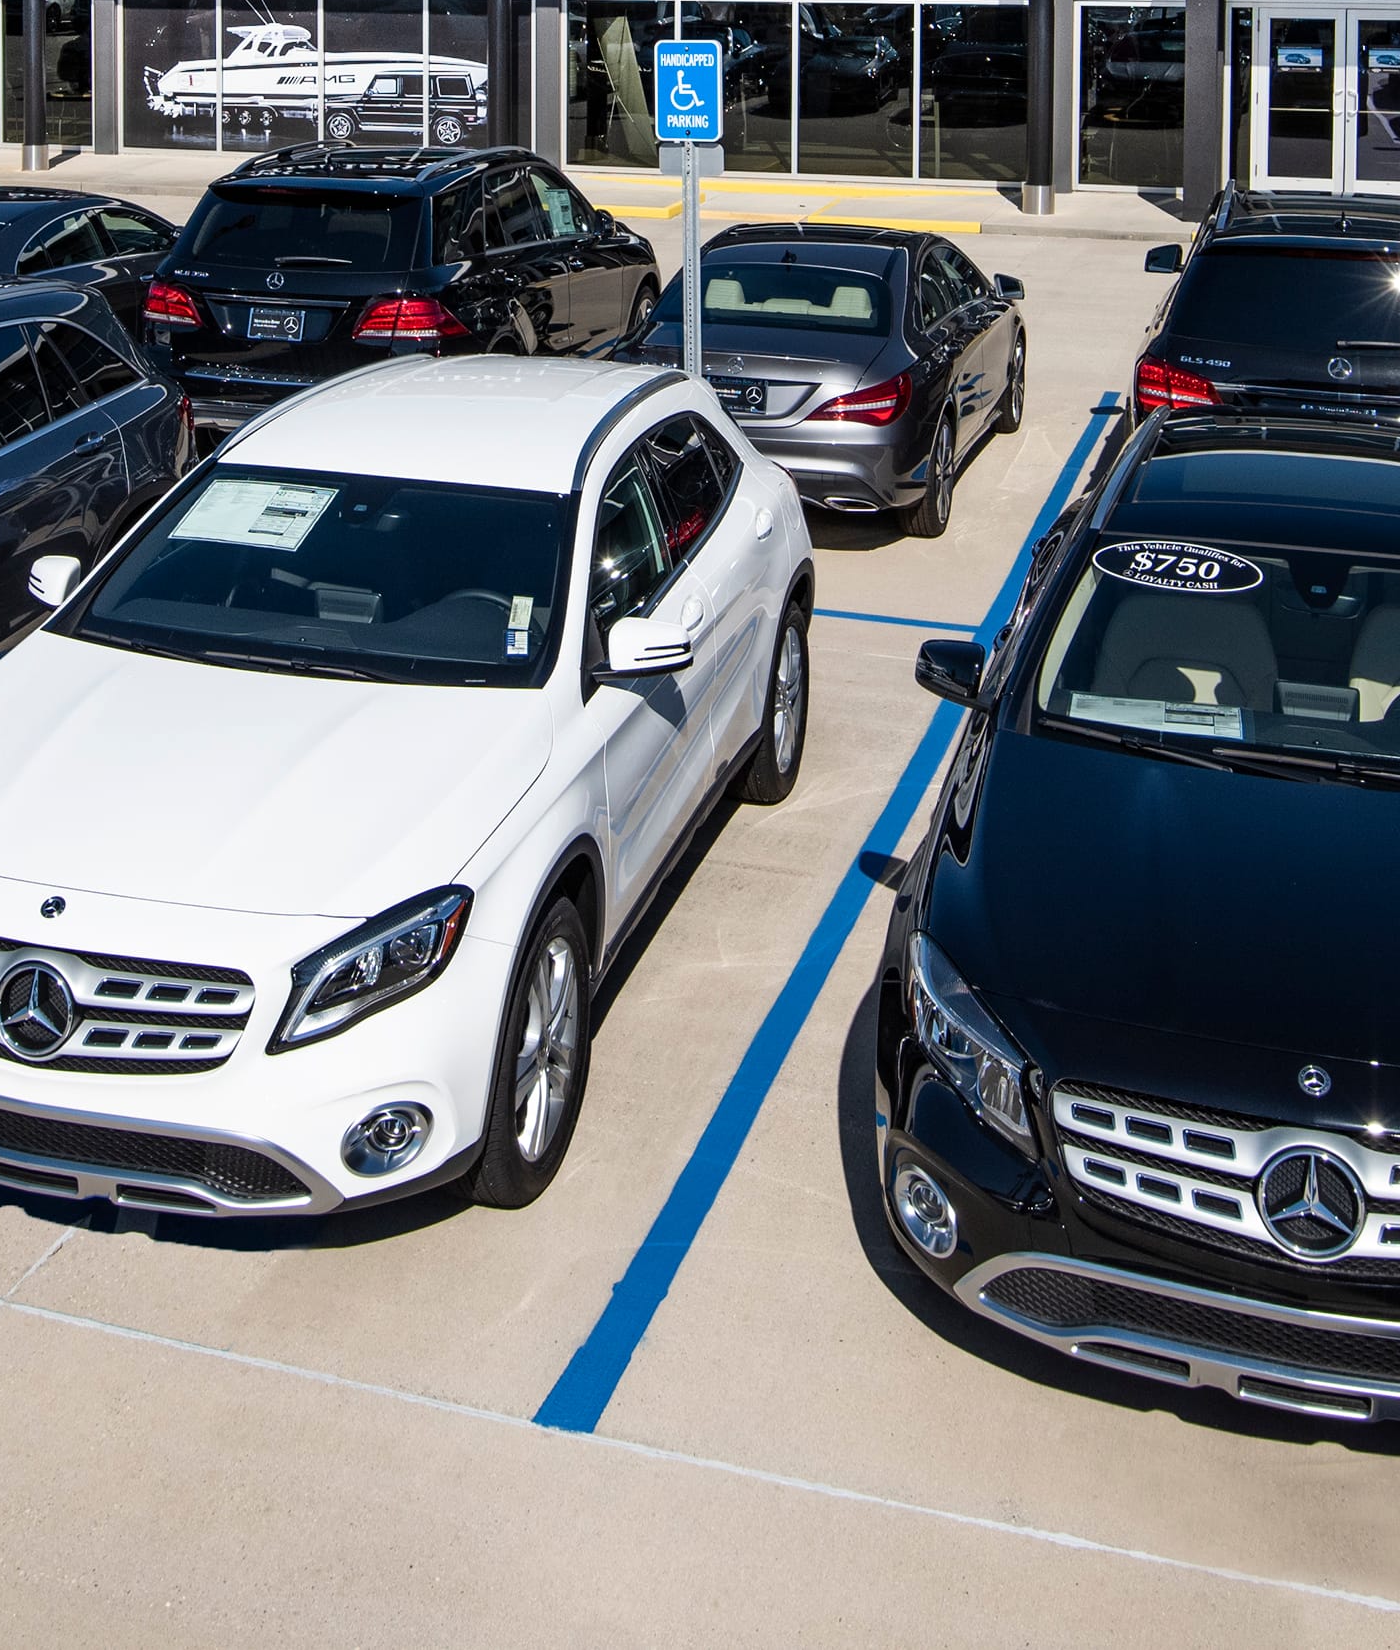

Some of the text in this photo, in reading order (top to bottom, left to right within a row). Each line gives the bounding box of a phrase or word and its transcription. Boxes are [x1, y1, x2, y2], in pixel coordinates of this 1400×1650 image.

[660, 53, 715, 67] HANDICAPPED
[667, 114, 709, 128] PARKING
[1179, 355, 1204, 365] GLS
[1116, 543, 1247, 569] This Vehicle Qualifies for
[1130, 550, 1221, 580] $750
[1134, 572, 1219, 590] LOYALTY CASH
